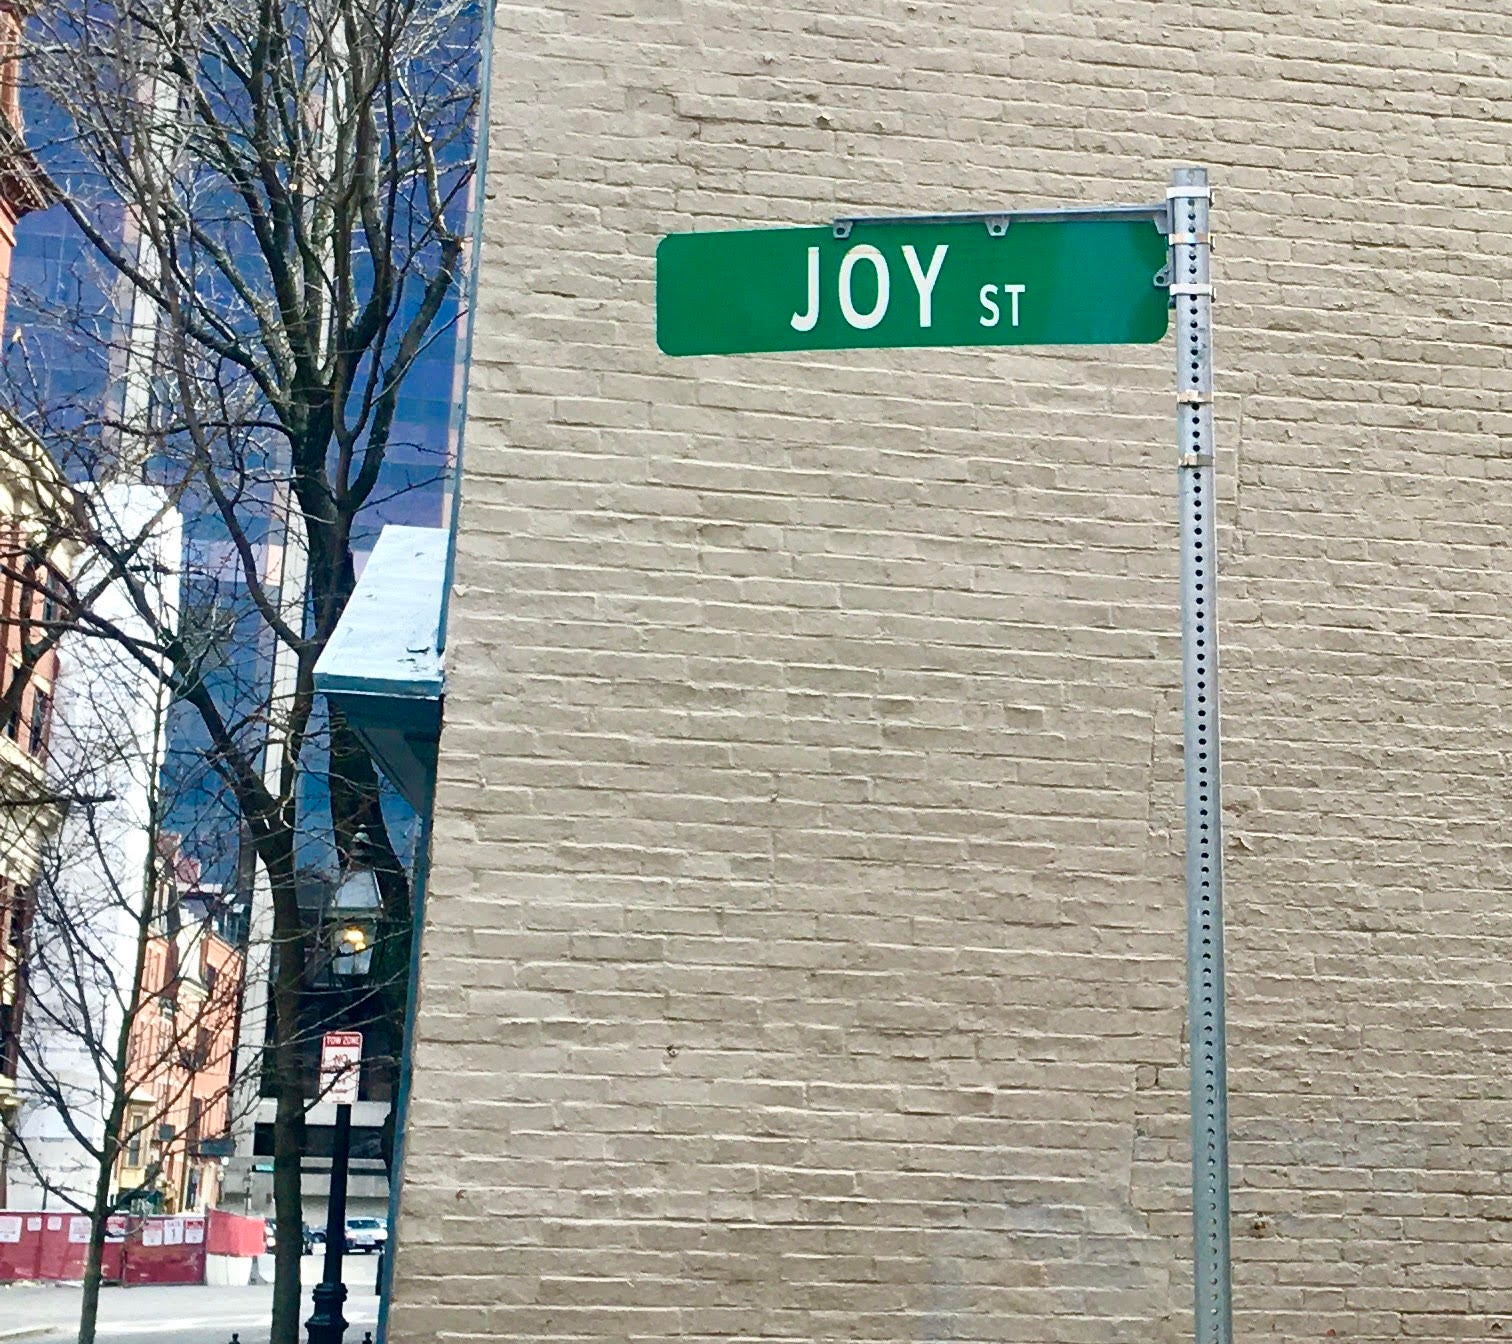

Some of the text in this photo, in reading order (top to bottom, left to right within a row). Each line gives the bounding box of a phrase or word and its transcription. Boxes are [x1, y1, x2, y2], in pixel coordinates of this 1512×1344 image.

[790, 244, 1026, 332] JOY ST
[326, 1035, 360, 1045] TOW ZONE
